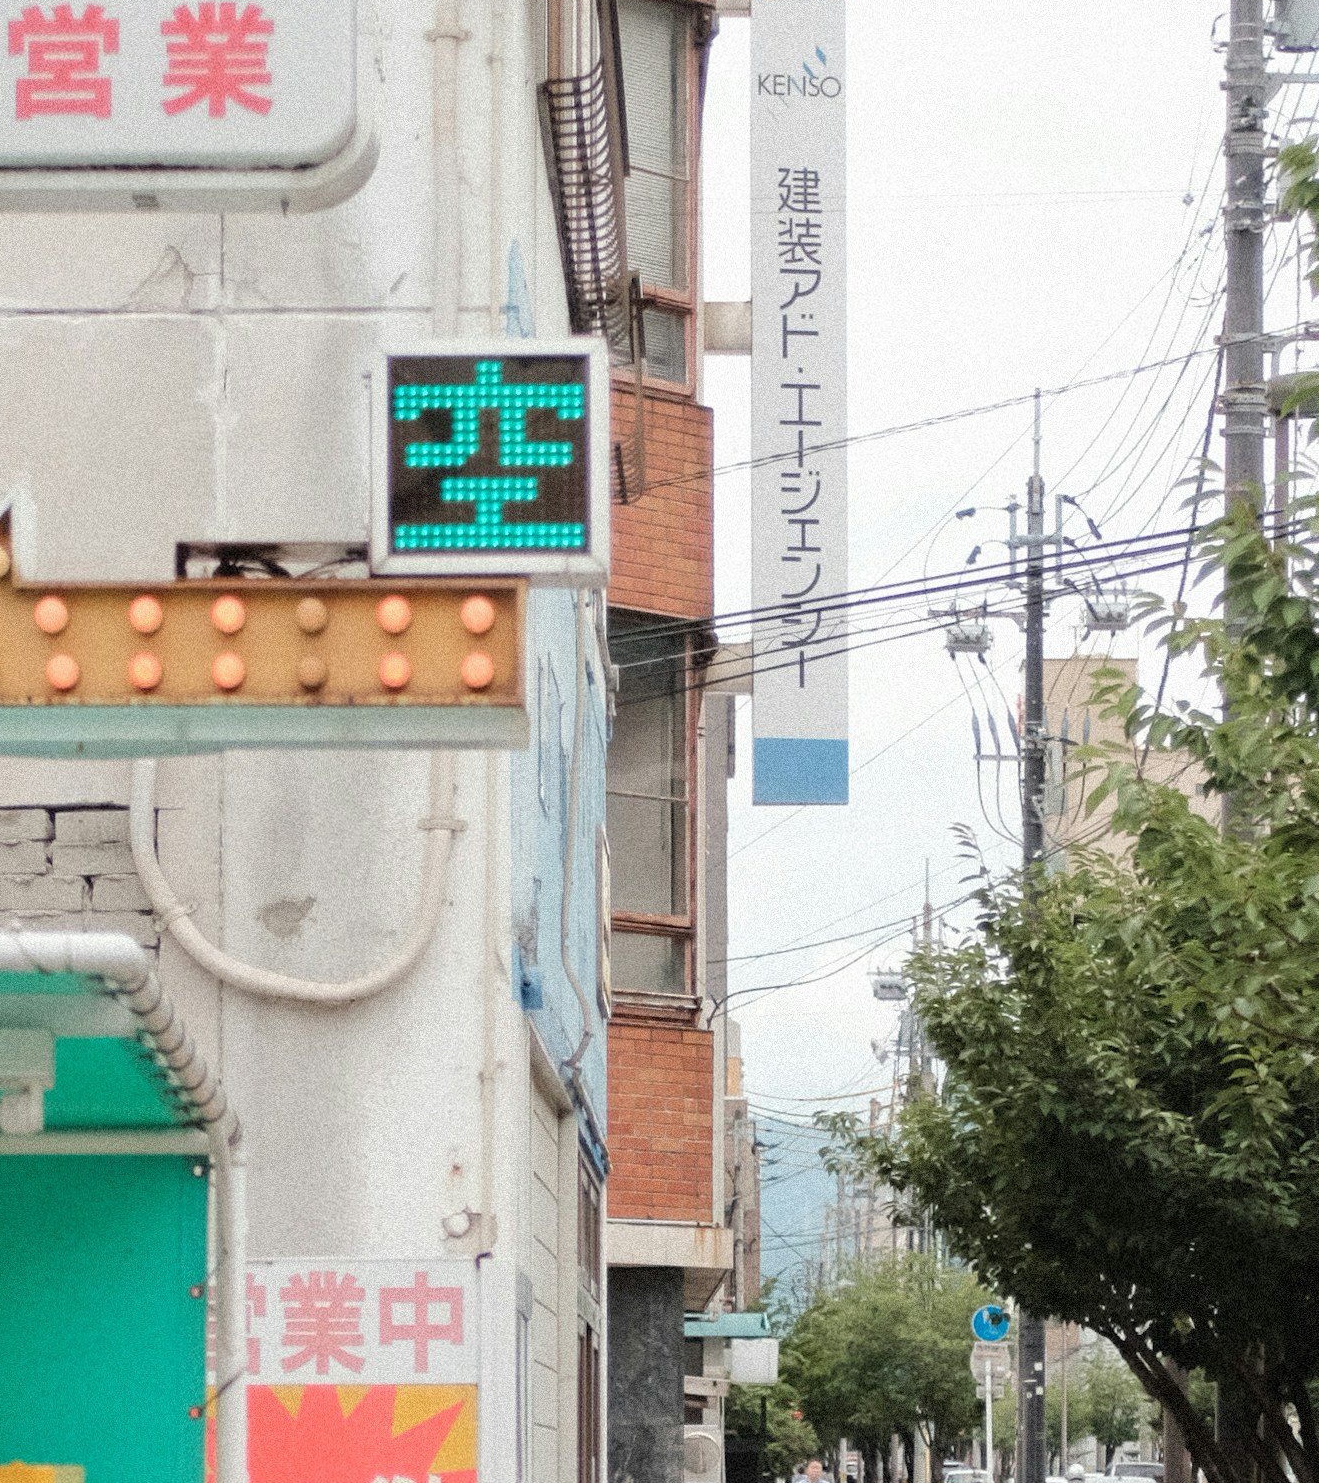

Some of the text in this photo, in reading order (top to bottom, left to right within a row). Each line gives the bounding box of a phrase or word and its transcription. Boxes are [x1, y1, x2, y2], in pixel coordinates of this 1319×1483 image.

[7, 3, 275, 121] 営業
[758, 74, 841, 98] KENSO
[395, 361, 583, 548] 空
[245, 1271, 464, 1374] 業中
